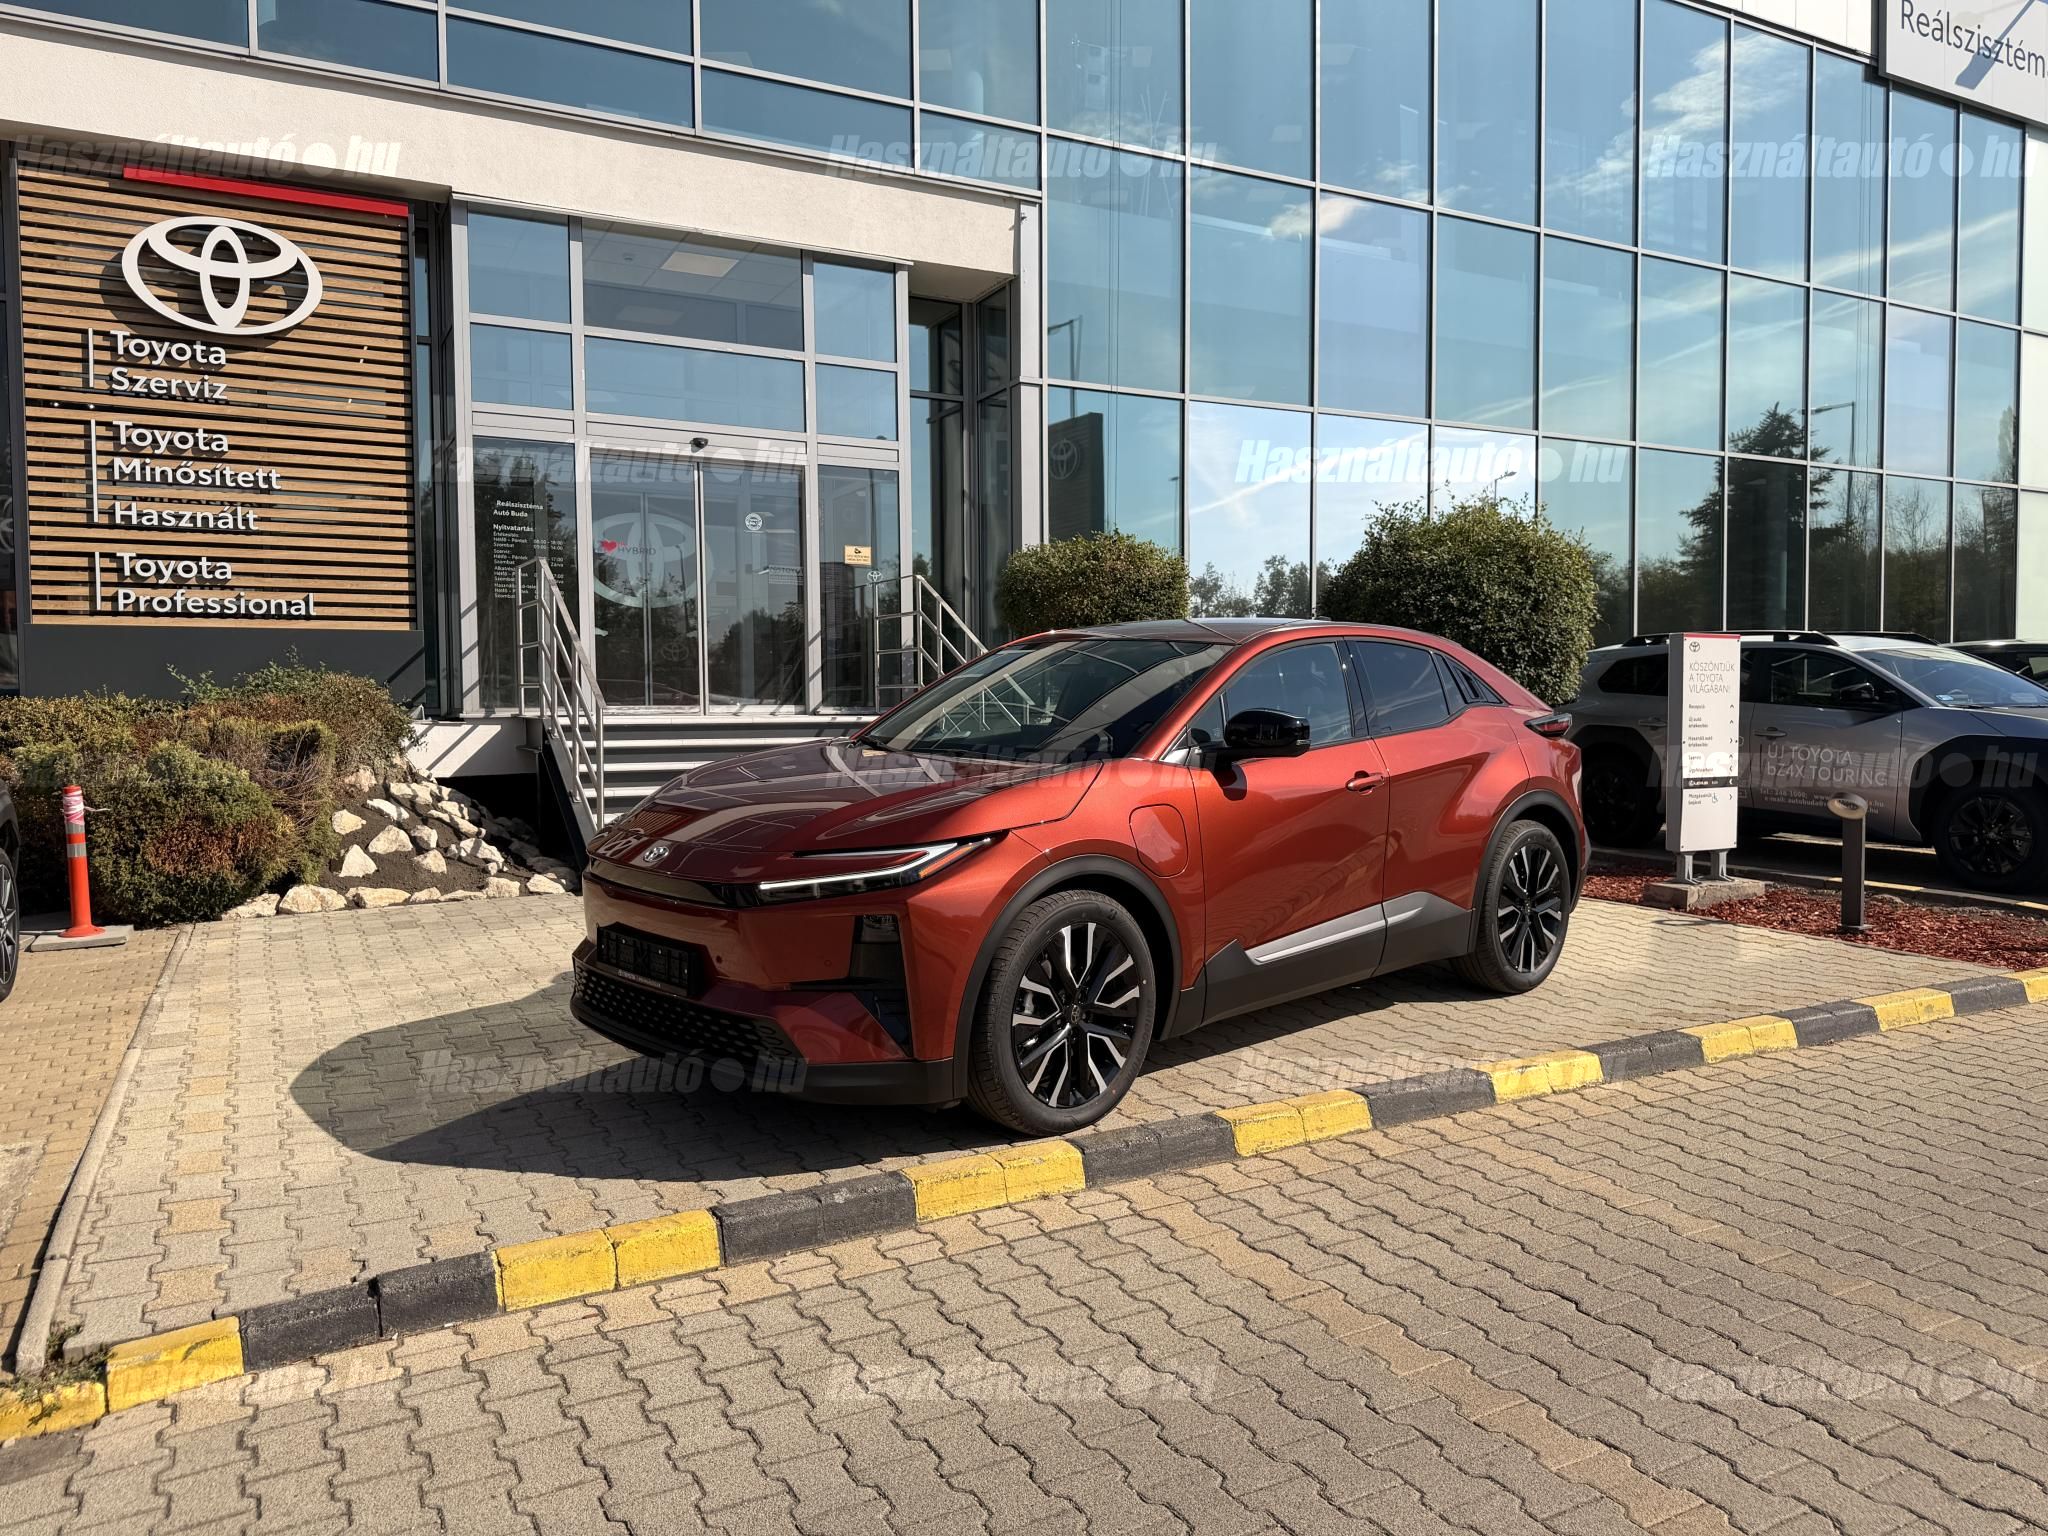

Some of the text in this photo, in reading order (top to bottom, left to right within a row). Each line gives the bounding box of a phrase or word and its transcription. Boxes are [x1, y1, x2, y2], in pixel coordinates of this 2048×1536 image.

[1900, 0, 2048, 79] Reálszisztém
[110, 330, 227, 365] Toyota
[111, 366, 228, 400] Szerviz
[112, 420, 229, 454] Toyota
[113, 457, 282, 490] Minősített
[114, 501, 260, 530] Használt
[511, 510, 528, 518] Buda
[116, 552, 233, 584] Toyota
[117, 588, 317, 616] Professional
[1696, 673, 1724, 682] TOYOTA
[1789, 743, 1854, 765] TOYOTA
[1767, 761, 1888, 786] bZ4X TOURING
